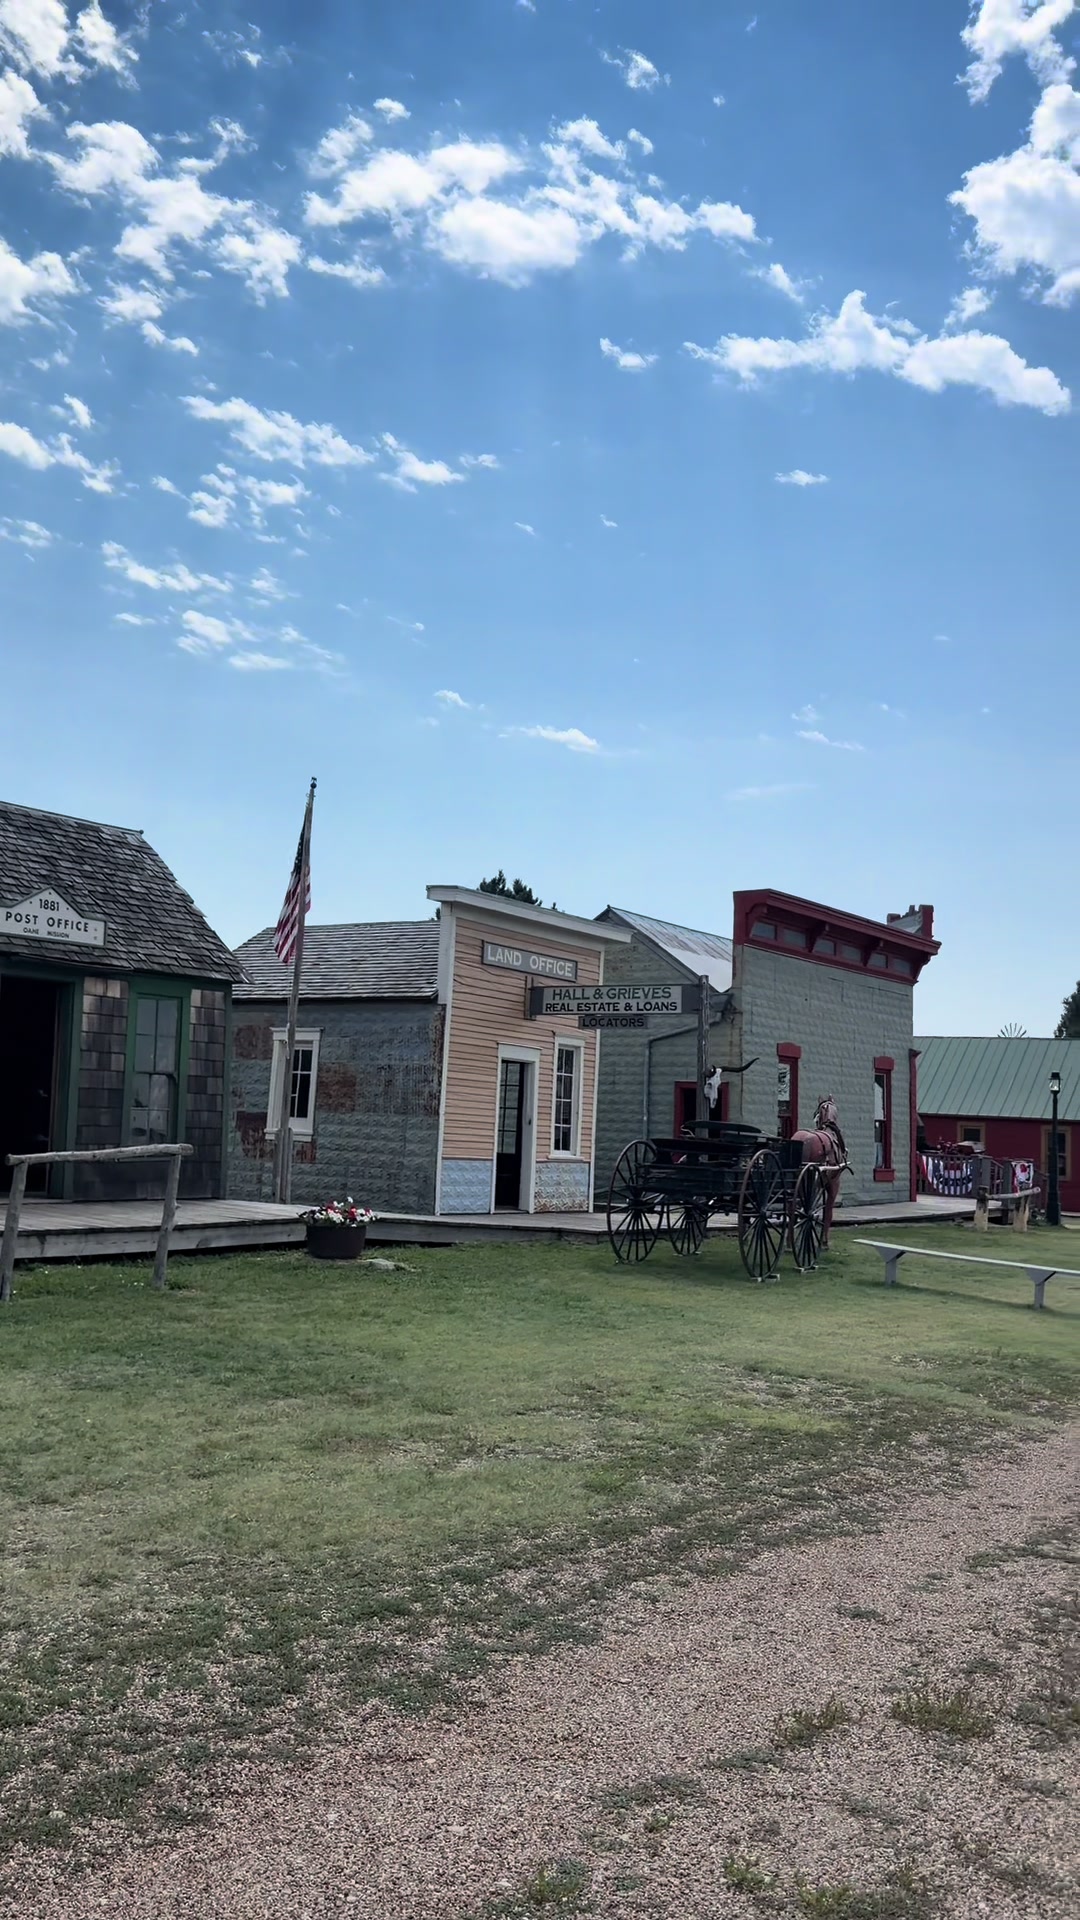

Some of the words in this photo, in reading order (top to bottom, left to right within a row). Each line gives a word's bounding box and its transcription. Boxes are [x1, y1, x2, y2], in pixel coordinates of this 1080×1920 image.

[39, 899, 59, 911] 1881
[5, 911, 38, 925] POST
[46, 917, 89, 932] OFFICE
[487, 945, 522, 966] LAND
[529, 955, 573, 977] OFFICE
[552, 988, 590, 1001] HALL
[592, 987, 604, 1000] &
[606, 986, 672, 1000] GRIEVES
[545, 1002, 574, 1013] REAL
[576, 1002, 620, 1012] ESTATE
[623, 1001, 633, 1012] &
[636, 1001, 678, 1012] LOANS
[582, 1017, 645, 1028] LOCATORS
